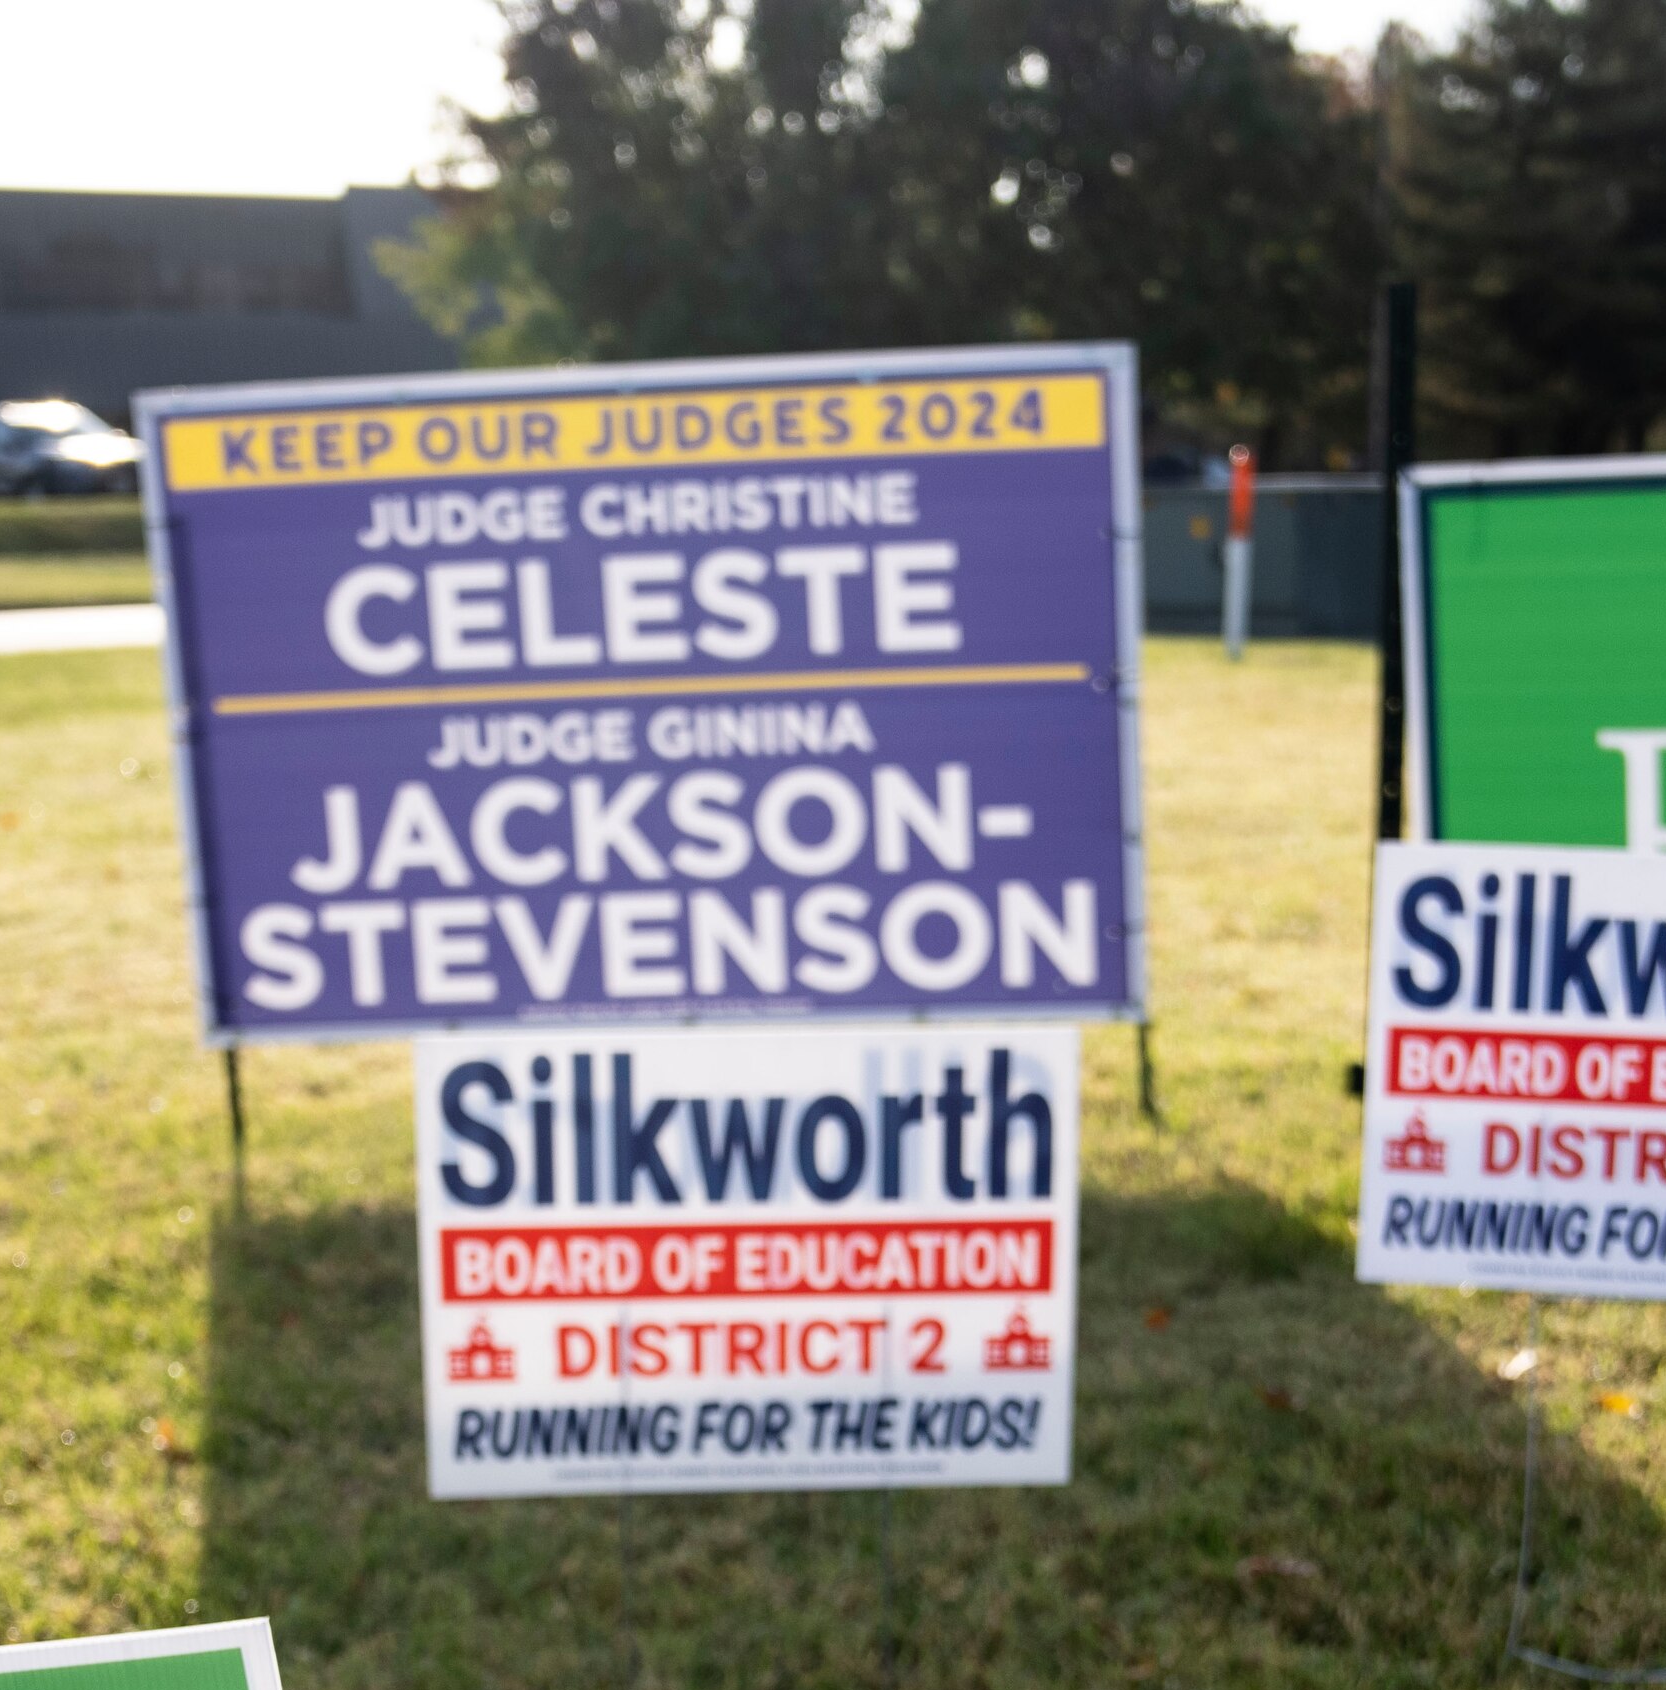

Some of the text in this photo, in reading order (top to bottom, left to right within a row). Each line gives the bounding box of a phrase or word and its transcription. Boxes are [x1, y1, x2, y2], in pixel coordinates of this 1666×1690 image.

[222, 389, 1044, 476] KEEP OUR JUDGES 2024
[358, 472, 917, 549] JUDGE CHRISTINE
[325, 541, 961, 674] CELESTE
[429, 703, 874, 768] JUDGE GININA
[291, 762, 1032, 894] JACKSON-
[240, 880, 1099, 1011] STEVENSON
[1397, 1036, 1569, 1097] BOARD
[1576, 1045, 1641, 1100] OF
[440, 1049, 1053, 1207] Silkworth
[1383, 1195, 1590, 1256] RUNNING
[453, 1229, 1038, 1297] BOARD OF EDUCATION
[555, 1317, 946, 1379] DISTRICT 2
[455, 1396, 1041, 1460] RUNNING FOR THE KIDS!
